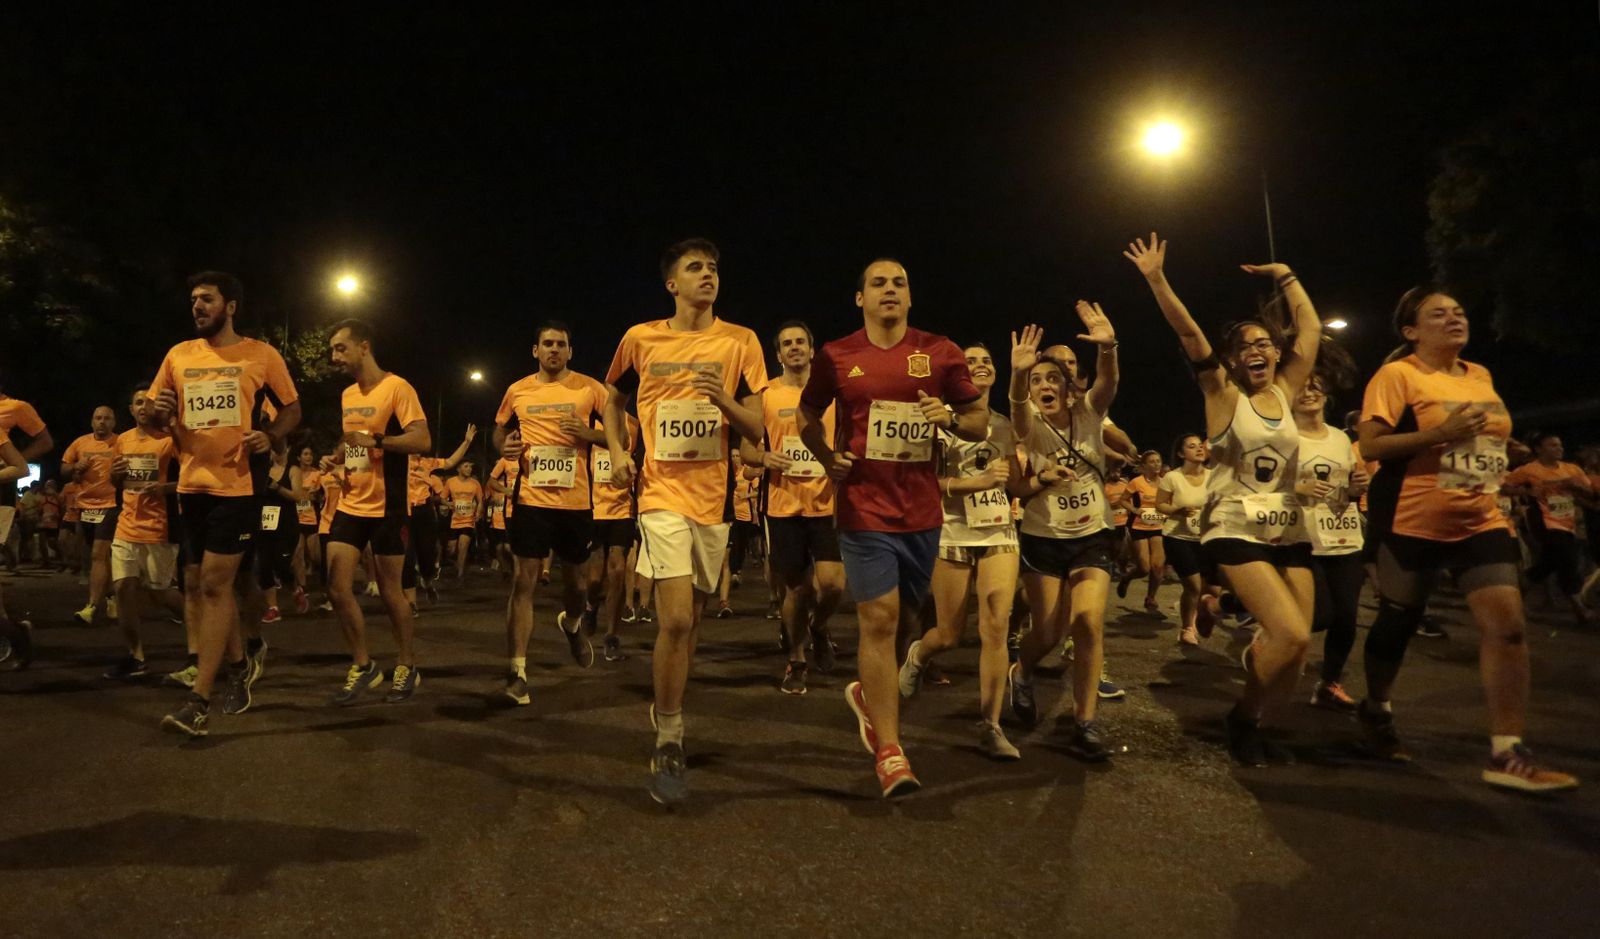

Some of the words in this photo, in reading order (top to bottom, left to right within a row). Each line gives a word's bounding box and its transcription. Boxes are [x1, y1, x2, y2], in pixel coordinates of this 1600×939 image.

[188, 394, 236, 411] 13428
[659, 420, 718, 438] 15007
[873, 420, 930, 439] 15002
[532, 458, 573, 472] 15005
[1057, 488, 1095, 510] 9651
[1256, 510, 1298, 526] 9009
[1319, 517, 1357, 530] 10265
